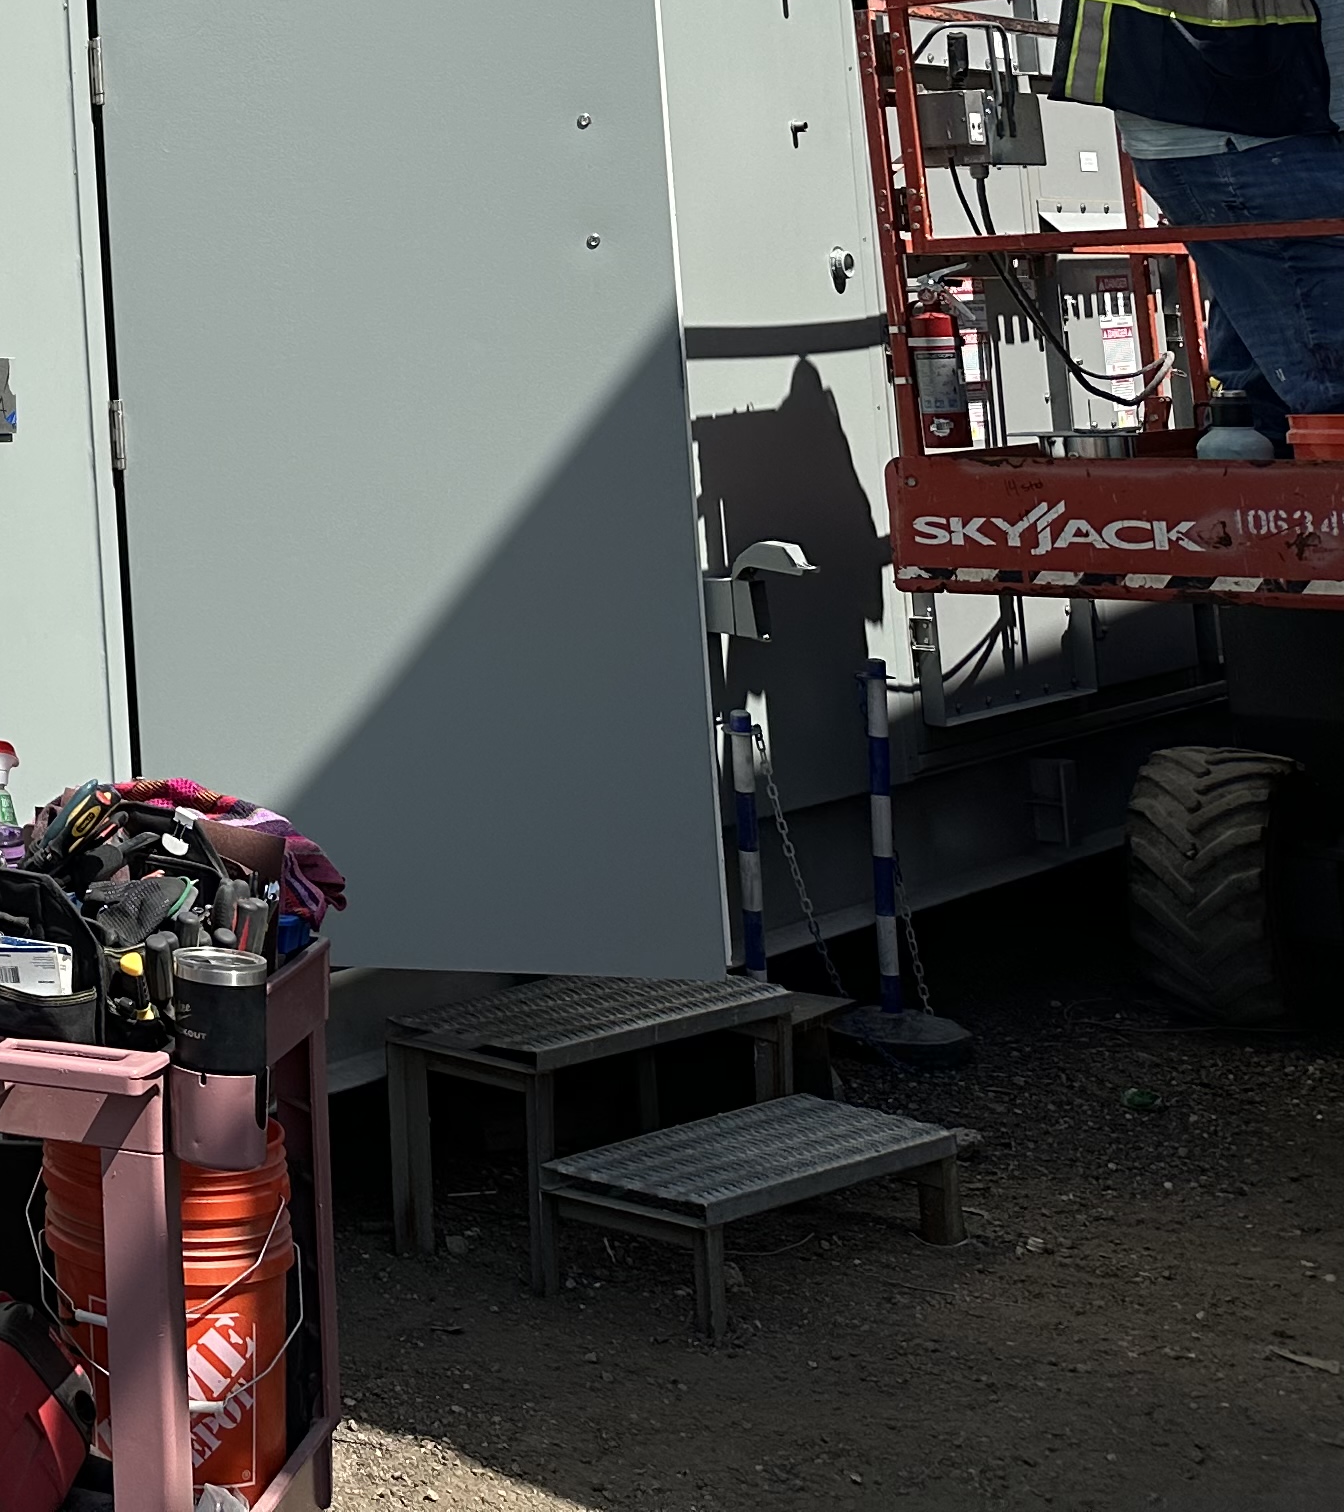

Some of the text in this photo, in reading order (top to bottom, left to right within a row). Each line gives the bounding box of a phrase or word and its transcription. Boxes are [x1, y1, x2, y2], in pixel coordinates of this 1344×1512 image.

[912, 499, 1207, 556] SKYJACK
[1233, 508, 1344, 537] 10634
[190, 1377, 256, 1469] EPOT
